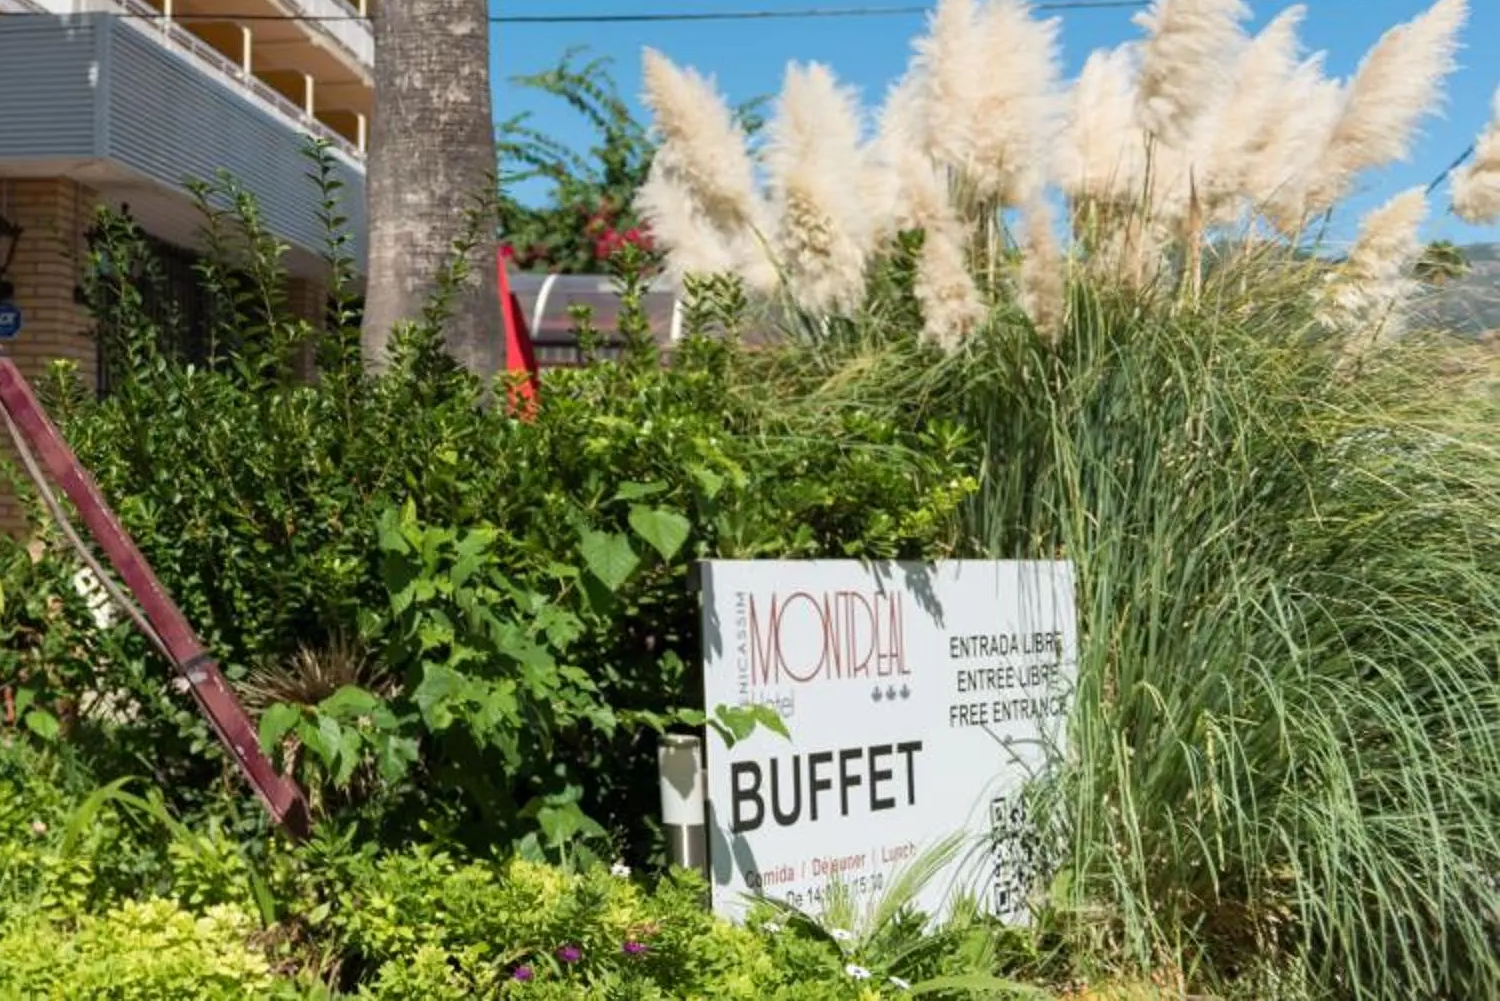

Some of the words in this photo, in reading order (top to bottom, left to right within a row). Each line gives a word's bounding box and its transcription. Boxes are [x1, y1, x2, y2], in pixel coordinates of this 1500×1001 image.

[749, 591, 911, 686] MONTREAL
[950, 634, 1018, 658] ENTRADA
[1019, 663, 1059, 688] LIBRE
[949, 702, 988, 727] FREE
[993, 697, 1067, 722] ENTRANCE
[730, 741, 922, 834] BUFFET
[746, 866, 794, 888] Comida
